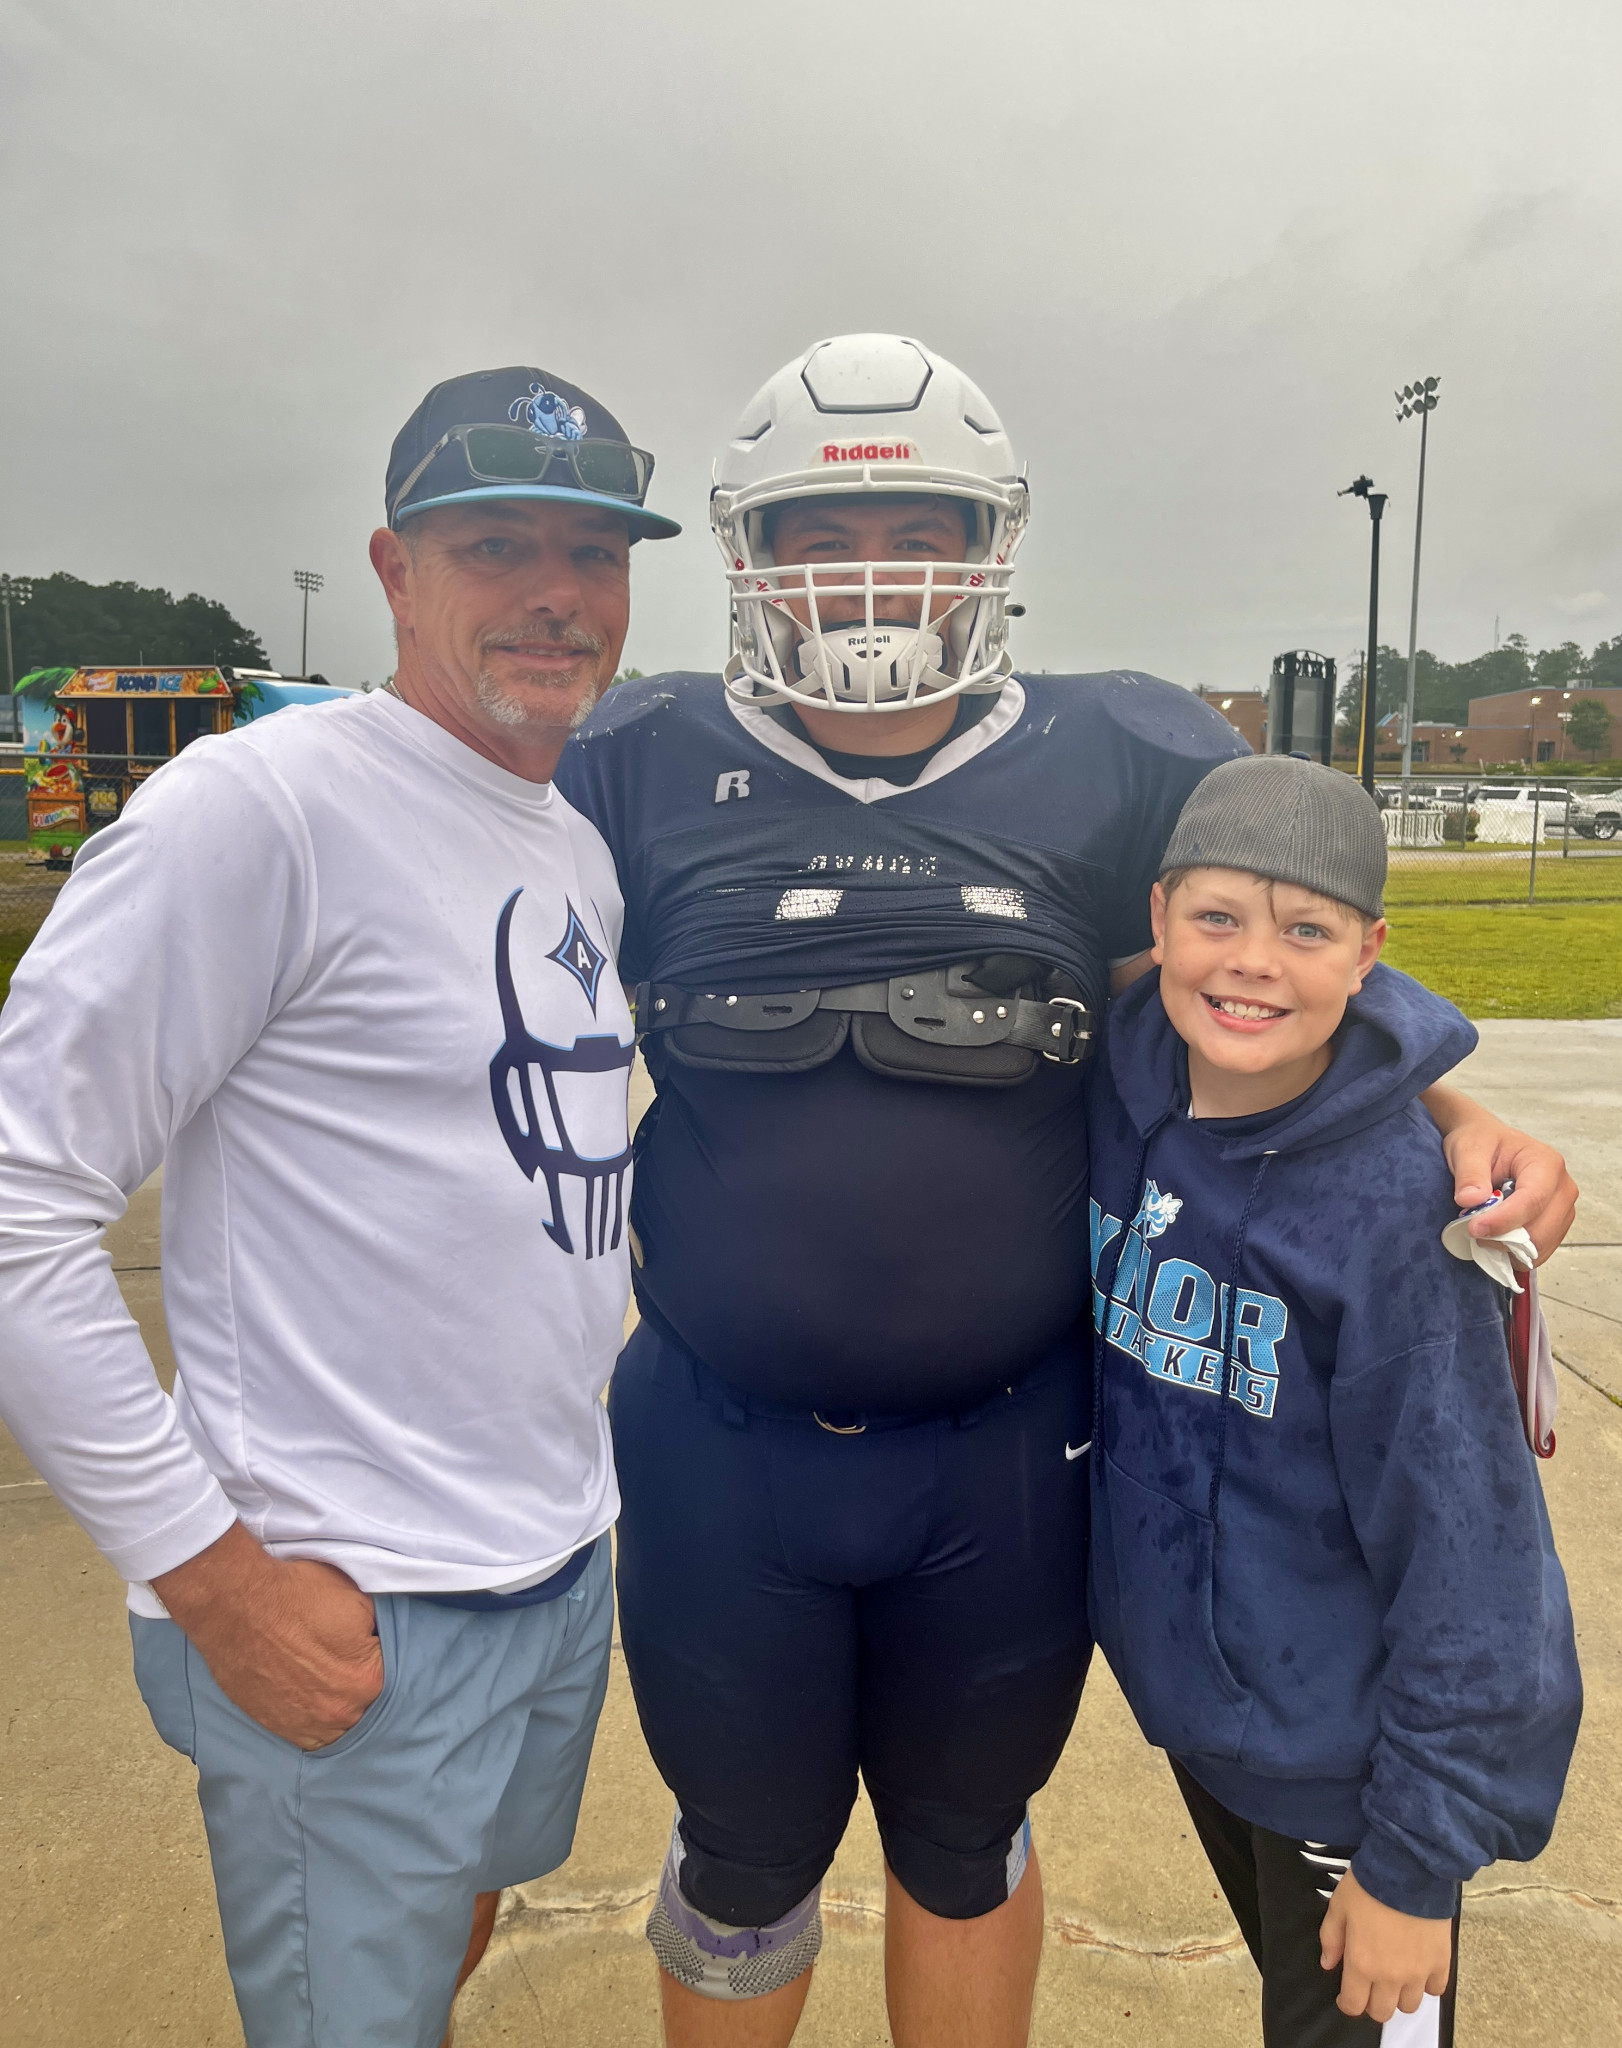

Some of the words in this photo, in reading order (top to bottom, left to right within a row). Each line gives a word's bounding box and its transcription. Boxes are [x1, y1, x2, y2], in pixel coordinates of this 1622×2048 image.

[823, 443, 910, 462] Riddell
[848, 635, 891, 646] Ridell
[158, 673, 184, 693] ICE
[715, 769, 750, 803] R
[577, 941, 592, 969] A
